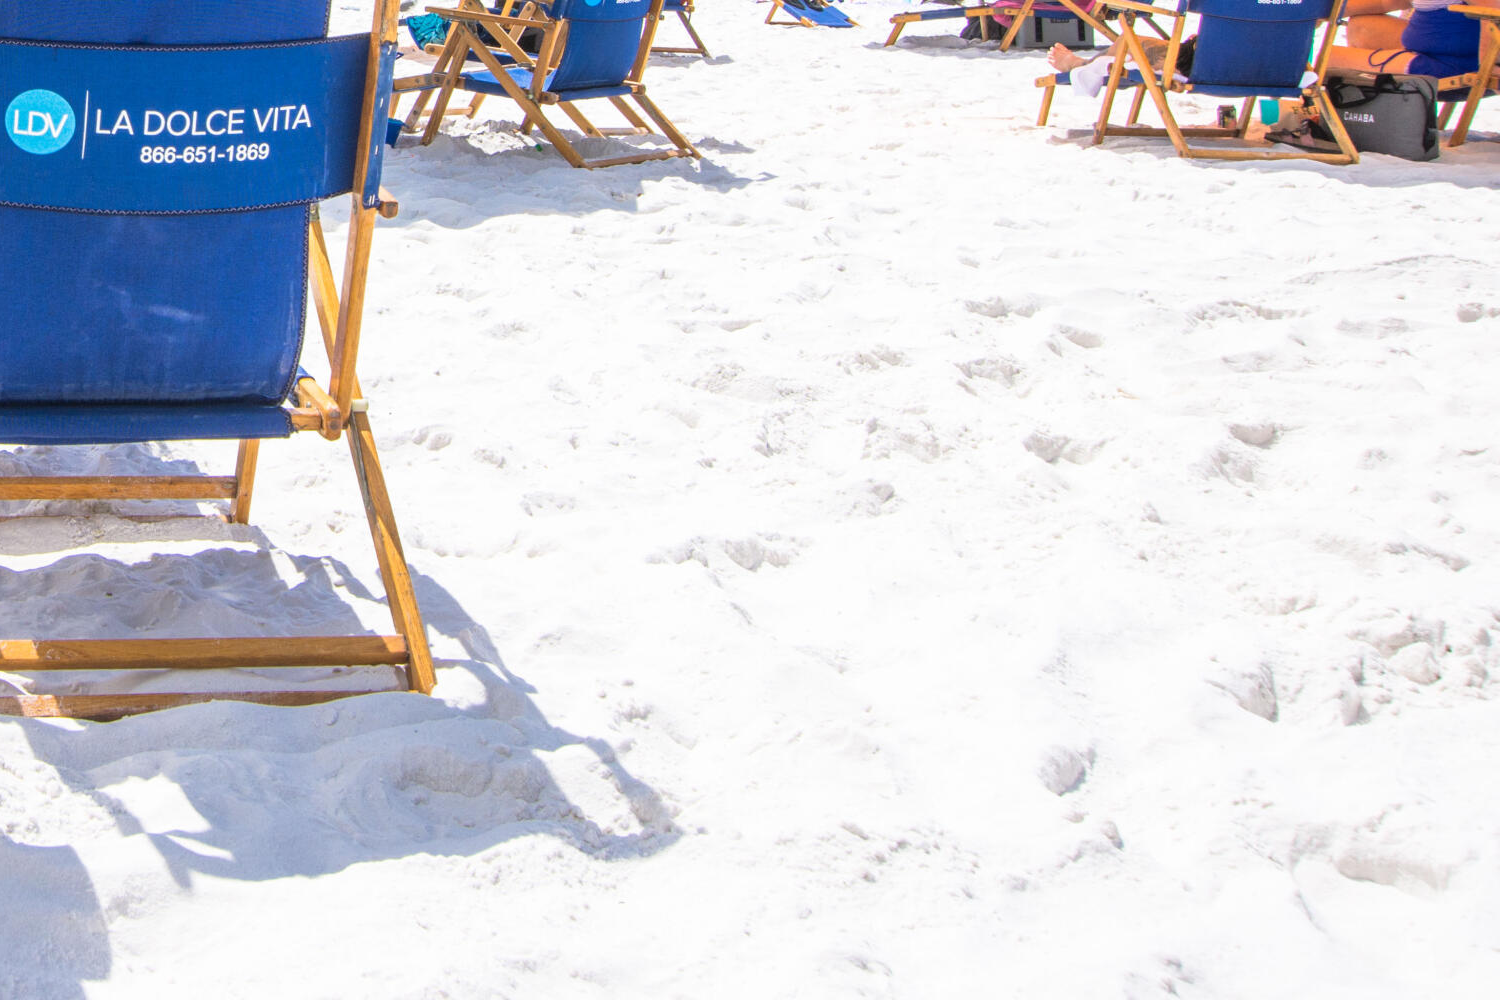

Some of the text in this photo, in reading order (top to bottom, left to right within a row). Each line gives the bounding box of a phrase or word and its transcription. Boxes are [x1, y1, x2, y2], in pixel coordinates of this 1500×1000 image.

[13, 108, 68, 139] LDV
[95, 103, 312, 137] LA DOLCE VITA
[139, 142, 270, 164] 866-651-1869
